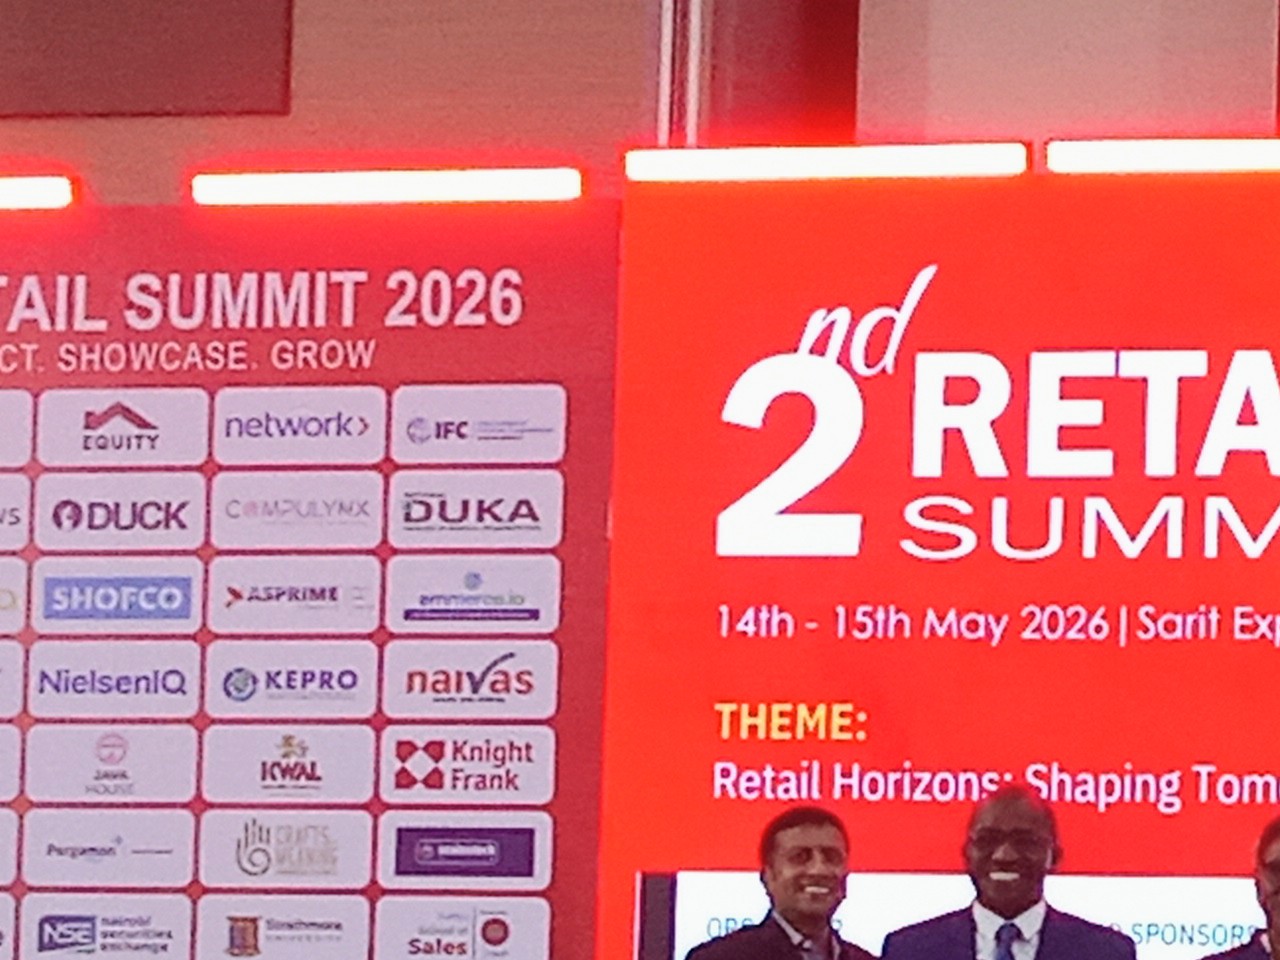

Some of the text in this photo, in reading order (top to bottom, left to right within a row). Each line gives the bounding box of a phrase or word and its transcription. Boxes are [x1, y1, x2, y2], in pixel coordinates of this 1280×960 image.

[0, 268, 523, 332] AIL SUMMIT 2026
[57, 340, 258, 372] SHOWCASE.
[271, 338, 376, 370] GROW
[225, 411, 352, 438] network
[435, 421, 469, 439] IFC
[83, 434, 159, 450] EQUITY
[87, 501, 190, 530] DUCK
[404, 499, 540, 522] DUKA
[52, 586, 184, 611] SHOFCO
[718, 605, 795, 638] 14th
[835, 605, 911, 640] 15th
[923, 607, 1009, 647] May
[1020, 604, 1110, 641] 2026
[1136, 604, 1221, 641] Sarit
[38, 669, 187, 696] NielsenIQ
[265, 669, 358, 690] KEPRO
[406, 652, 534, 695] naivas
[714, 702, 868, 741] THEME:
[451, 740, 534, 767] Knight
[451, 768, 520, 791] Frank
[713, 760, 821, 800] Retail
[1025, 762, 1182, 815] Shaping
[42, 921, 94, 947] NSE
[408, 937, 468, 955] Sales
